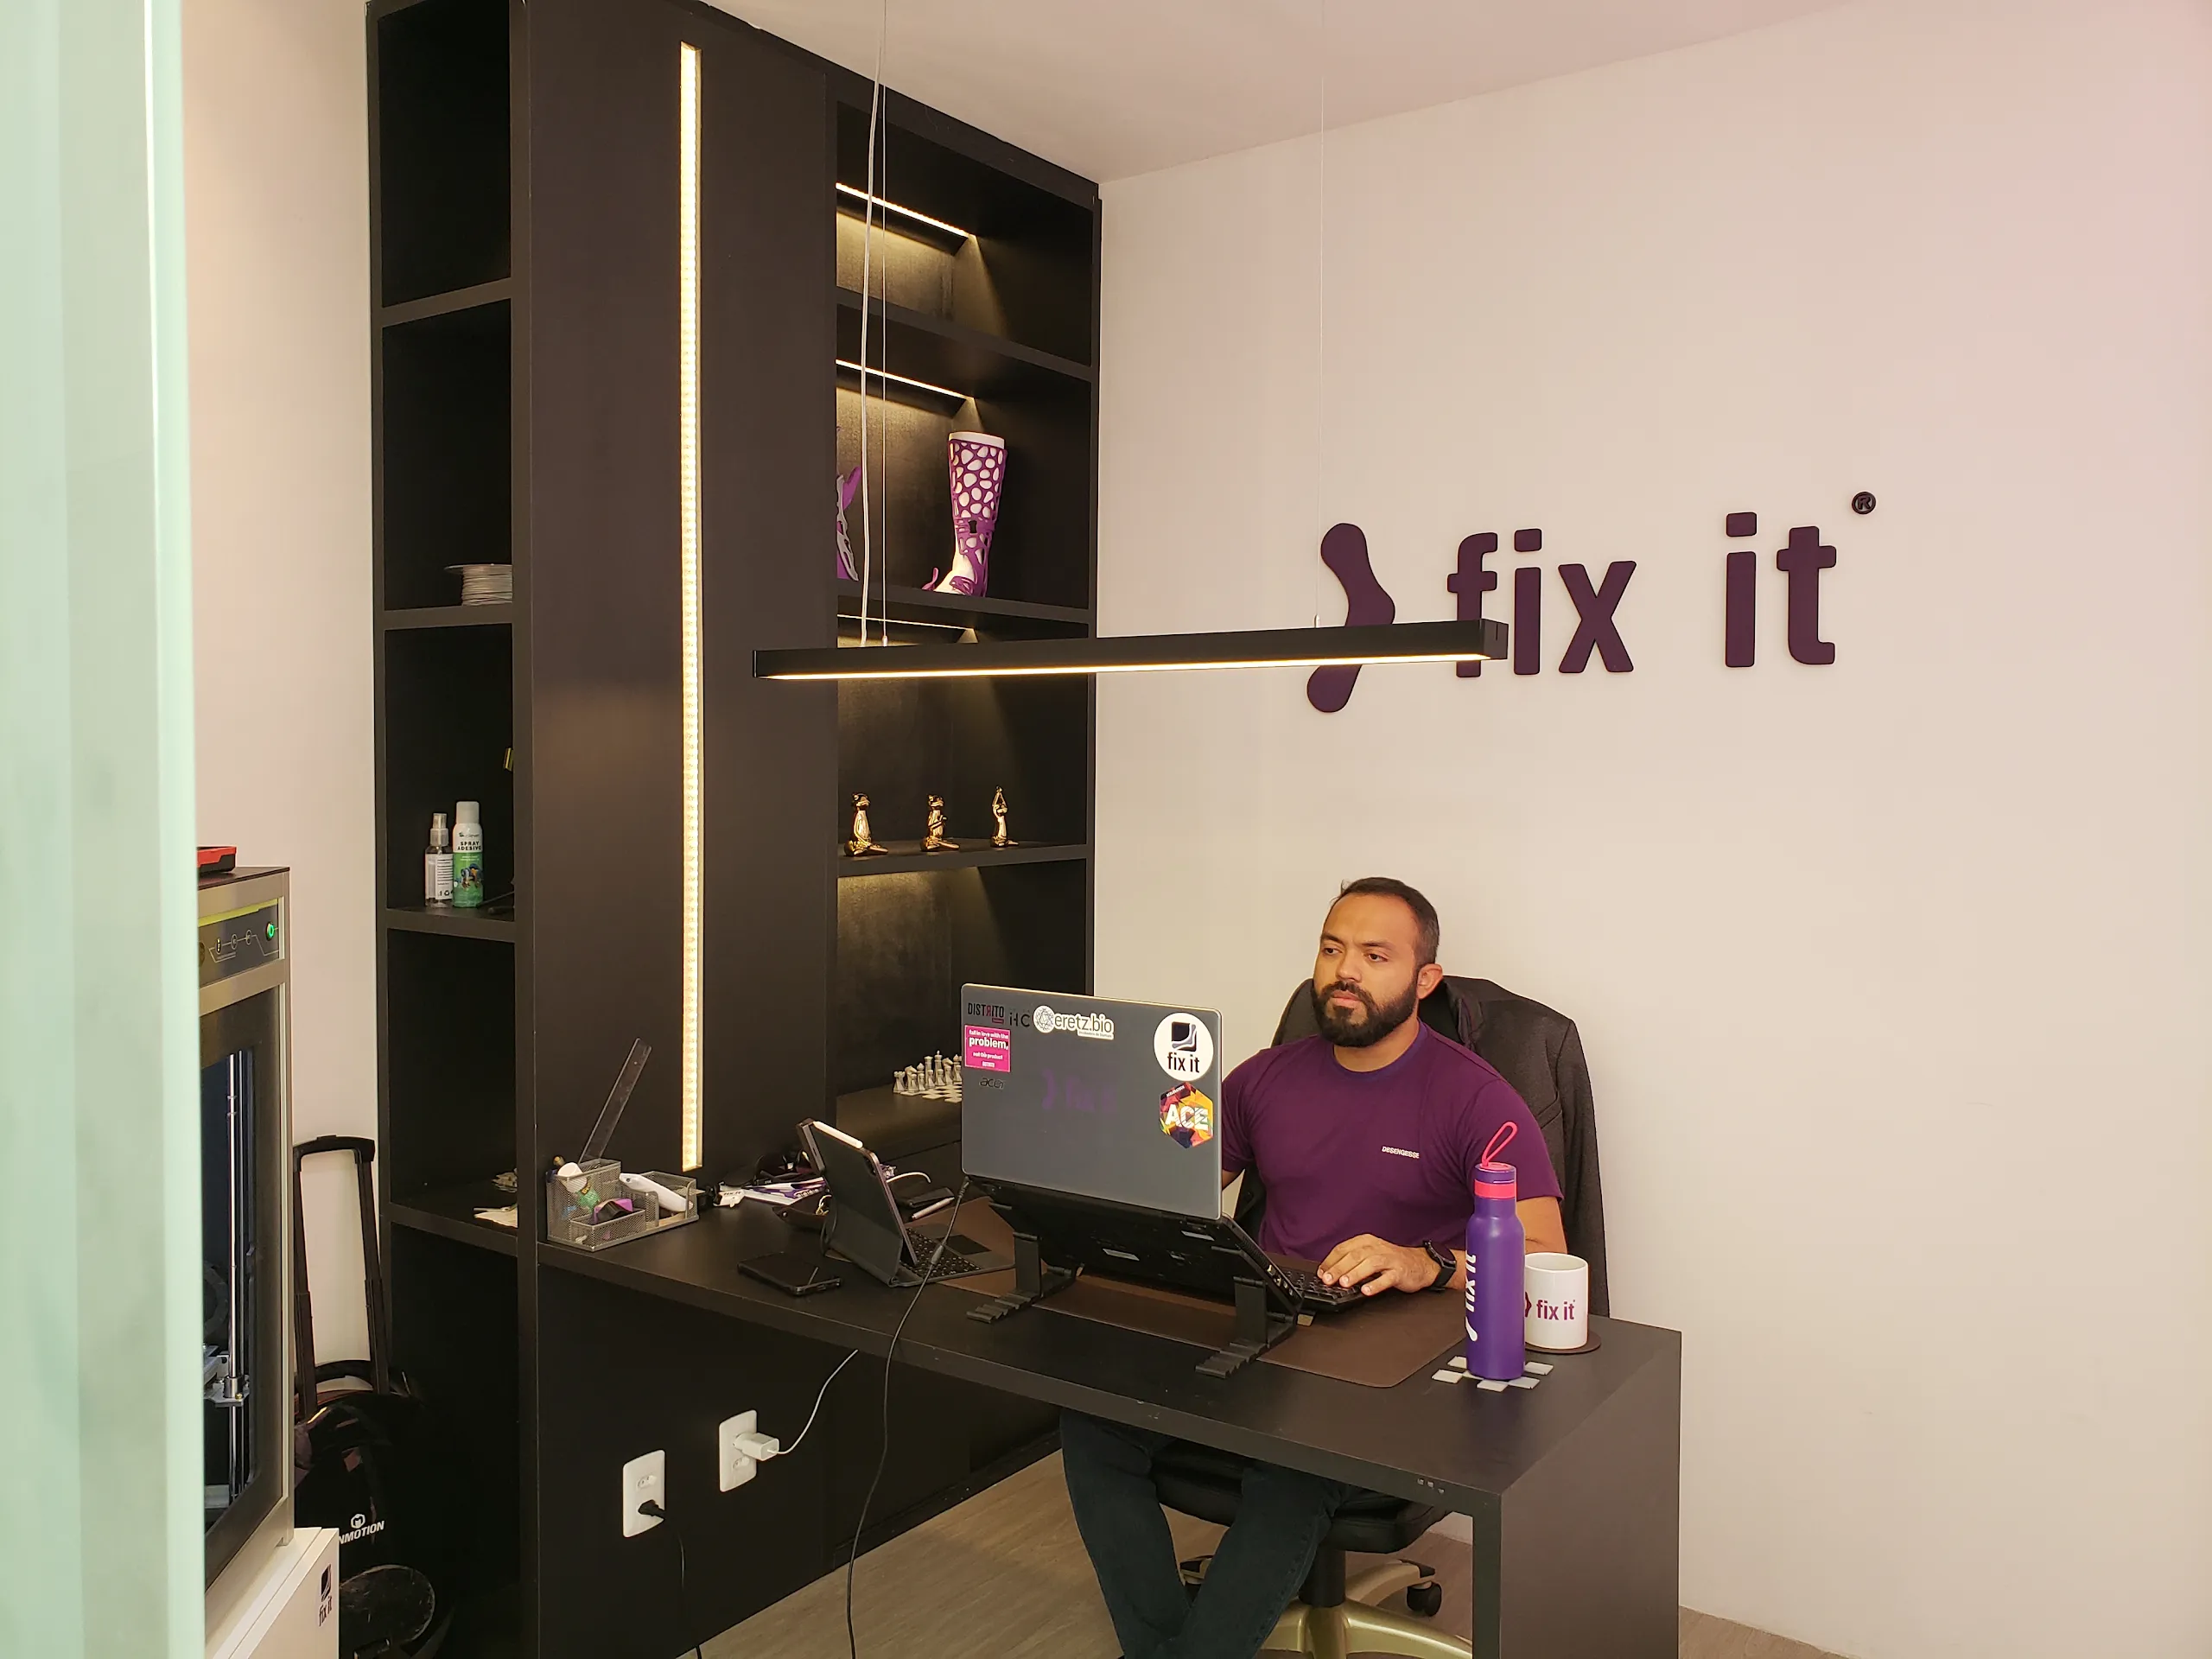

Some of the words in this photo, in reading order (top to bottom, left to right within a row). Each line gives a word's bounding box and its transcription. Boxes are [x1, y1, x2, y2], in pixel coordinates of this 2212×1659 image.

[1446, 528, 1637, 677] fix
[1725, 512, 1837, 668] it
[1054, 1014, 1112, 1033] eretz.bio
[969, 1037, 1008, 1050] problem,
[1167, 1052, 1185, 1071] fix
[1190, 1053, 1199, 1073] it
[1165, 1103, 1209, 1131] ACE
[1536, 1300, 1559, 1320] fix
[1563, 1301, 1575, 1321] it
[327, 1595, 333, 1615] it
